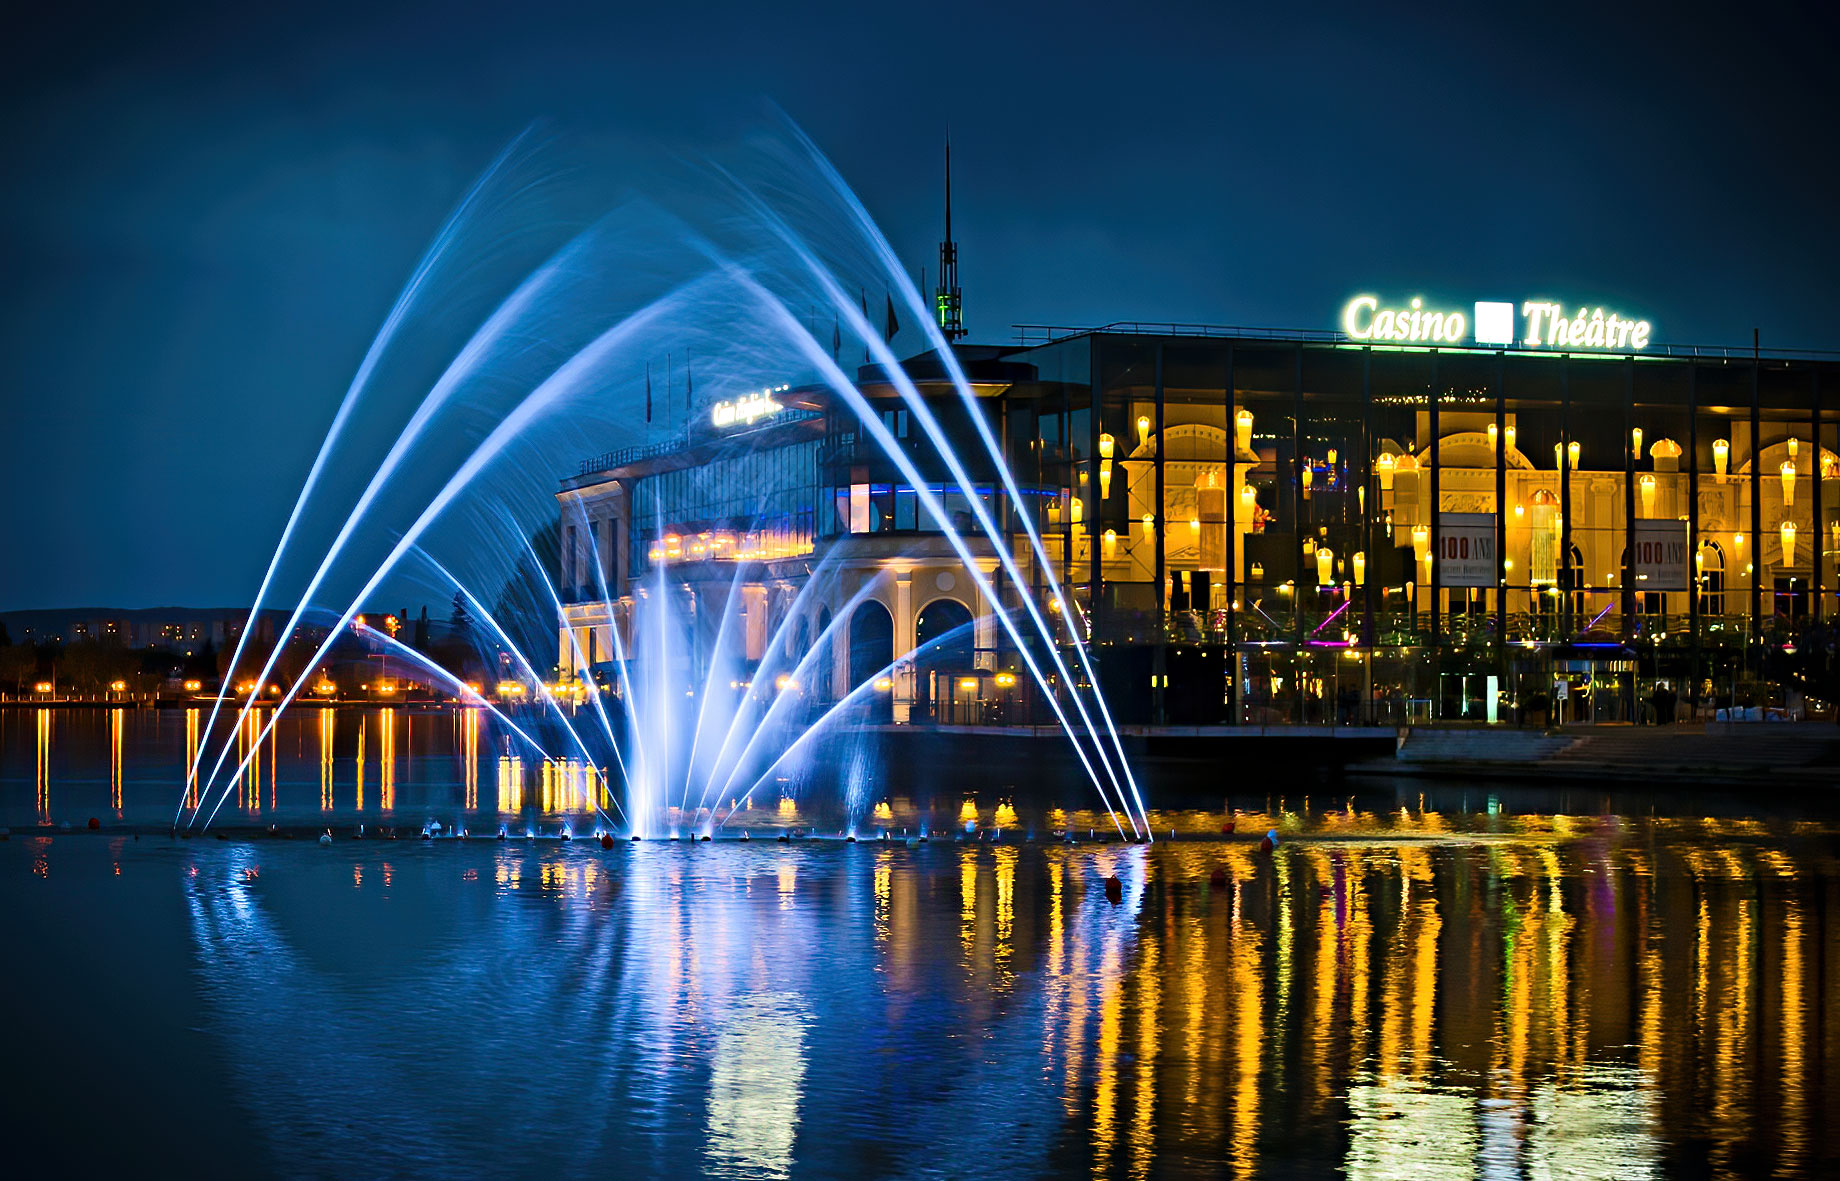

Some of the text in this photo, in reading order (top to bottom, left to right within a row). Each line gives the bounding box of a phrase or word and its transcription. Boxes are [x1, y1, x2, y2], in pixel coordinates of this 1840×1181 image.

[1345, 296, 1651, 349] Casino Théâtre
[1441, 536, 1469, 560] 100
[1636, 541, 1663, 564] 100
